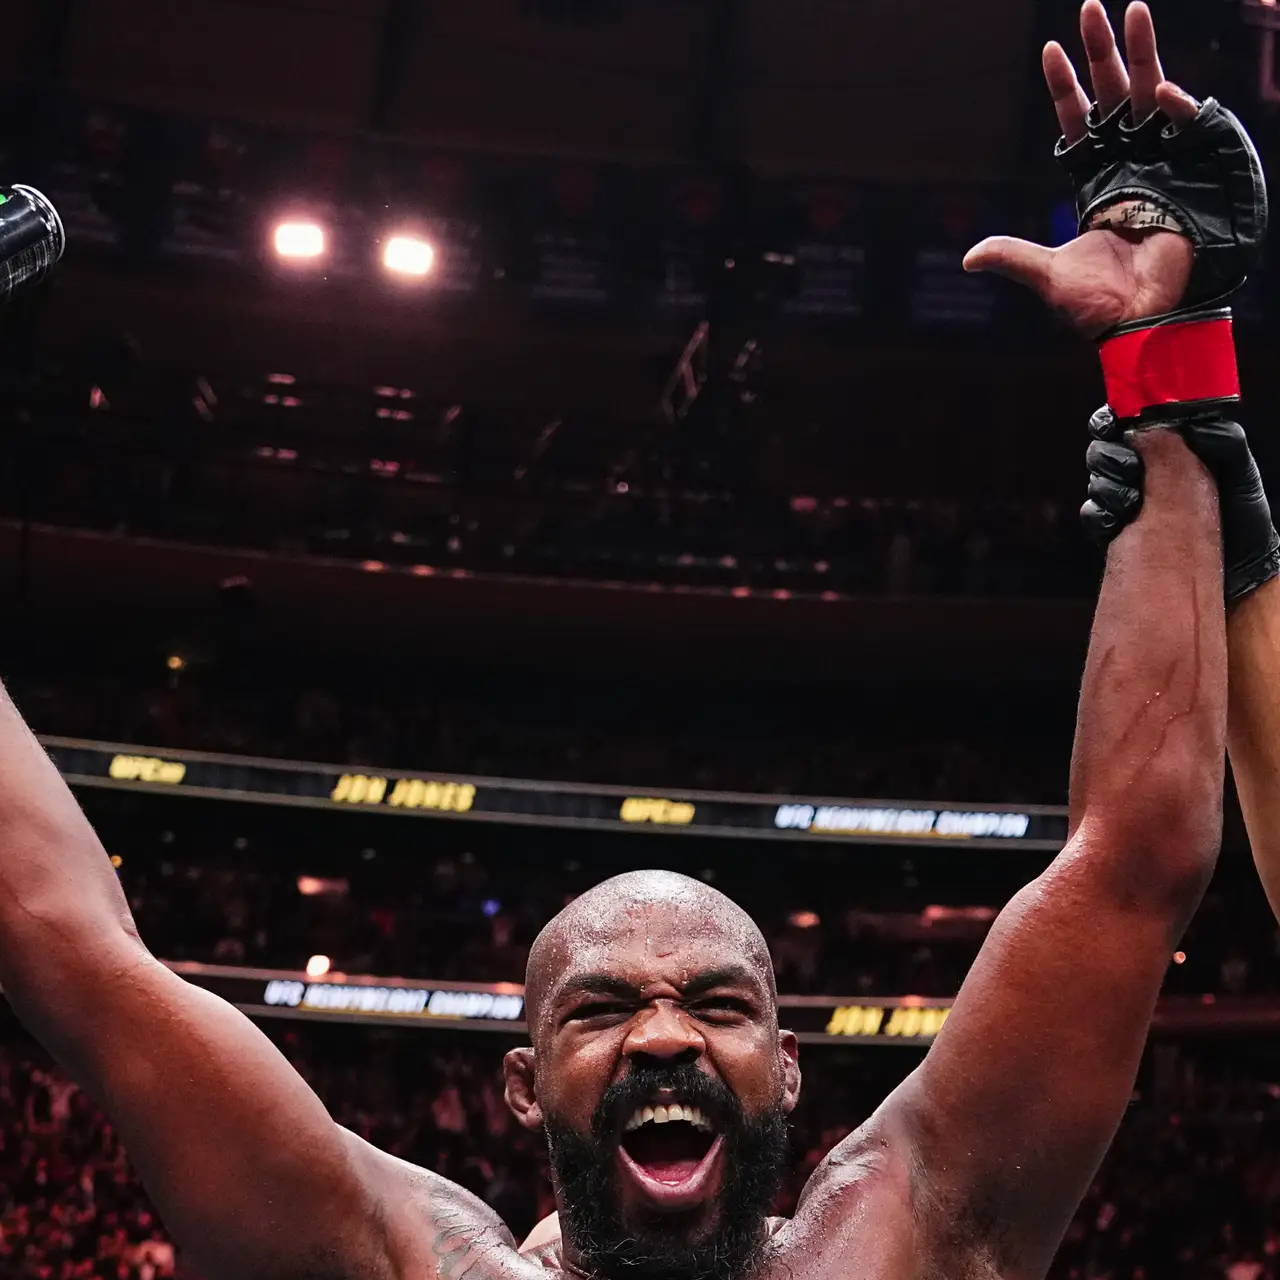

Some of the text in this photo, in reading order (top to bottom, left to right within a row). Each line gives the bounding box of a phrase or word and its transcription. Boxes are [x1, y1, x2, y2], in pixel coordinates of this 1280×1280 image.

[330, 772, 478, 814] JON JONES
[774, 803, 815, 829] UFC
[825, 1005, 952, 1038] JON JON
